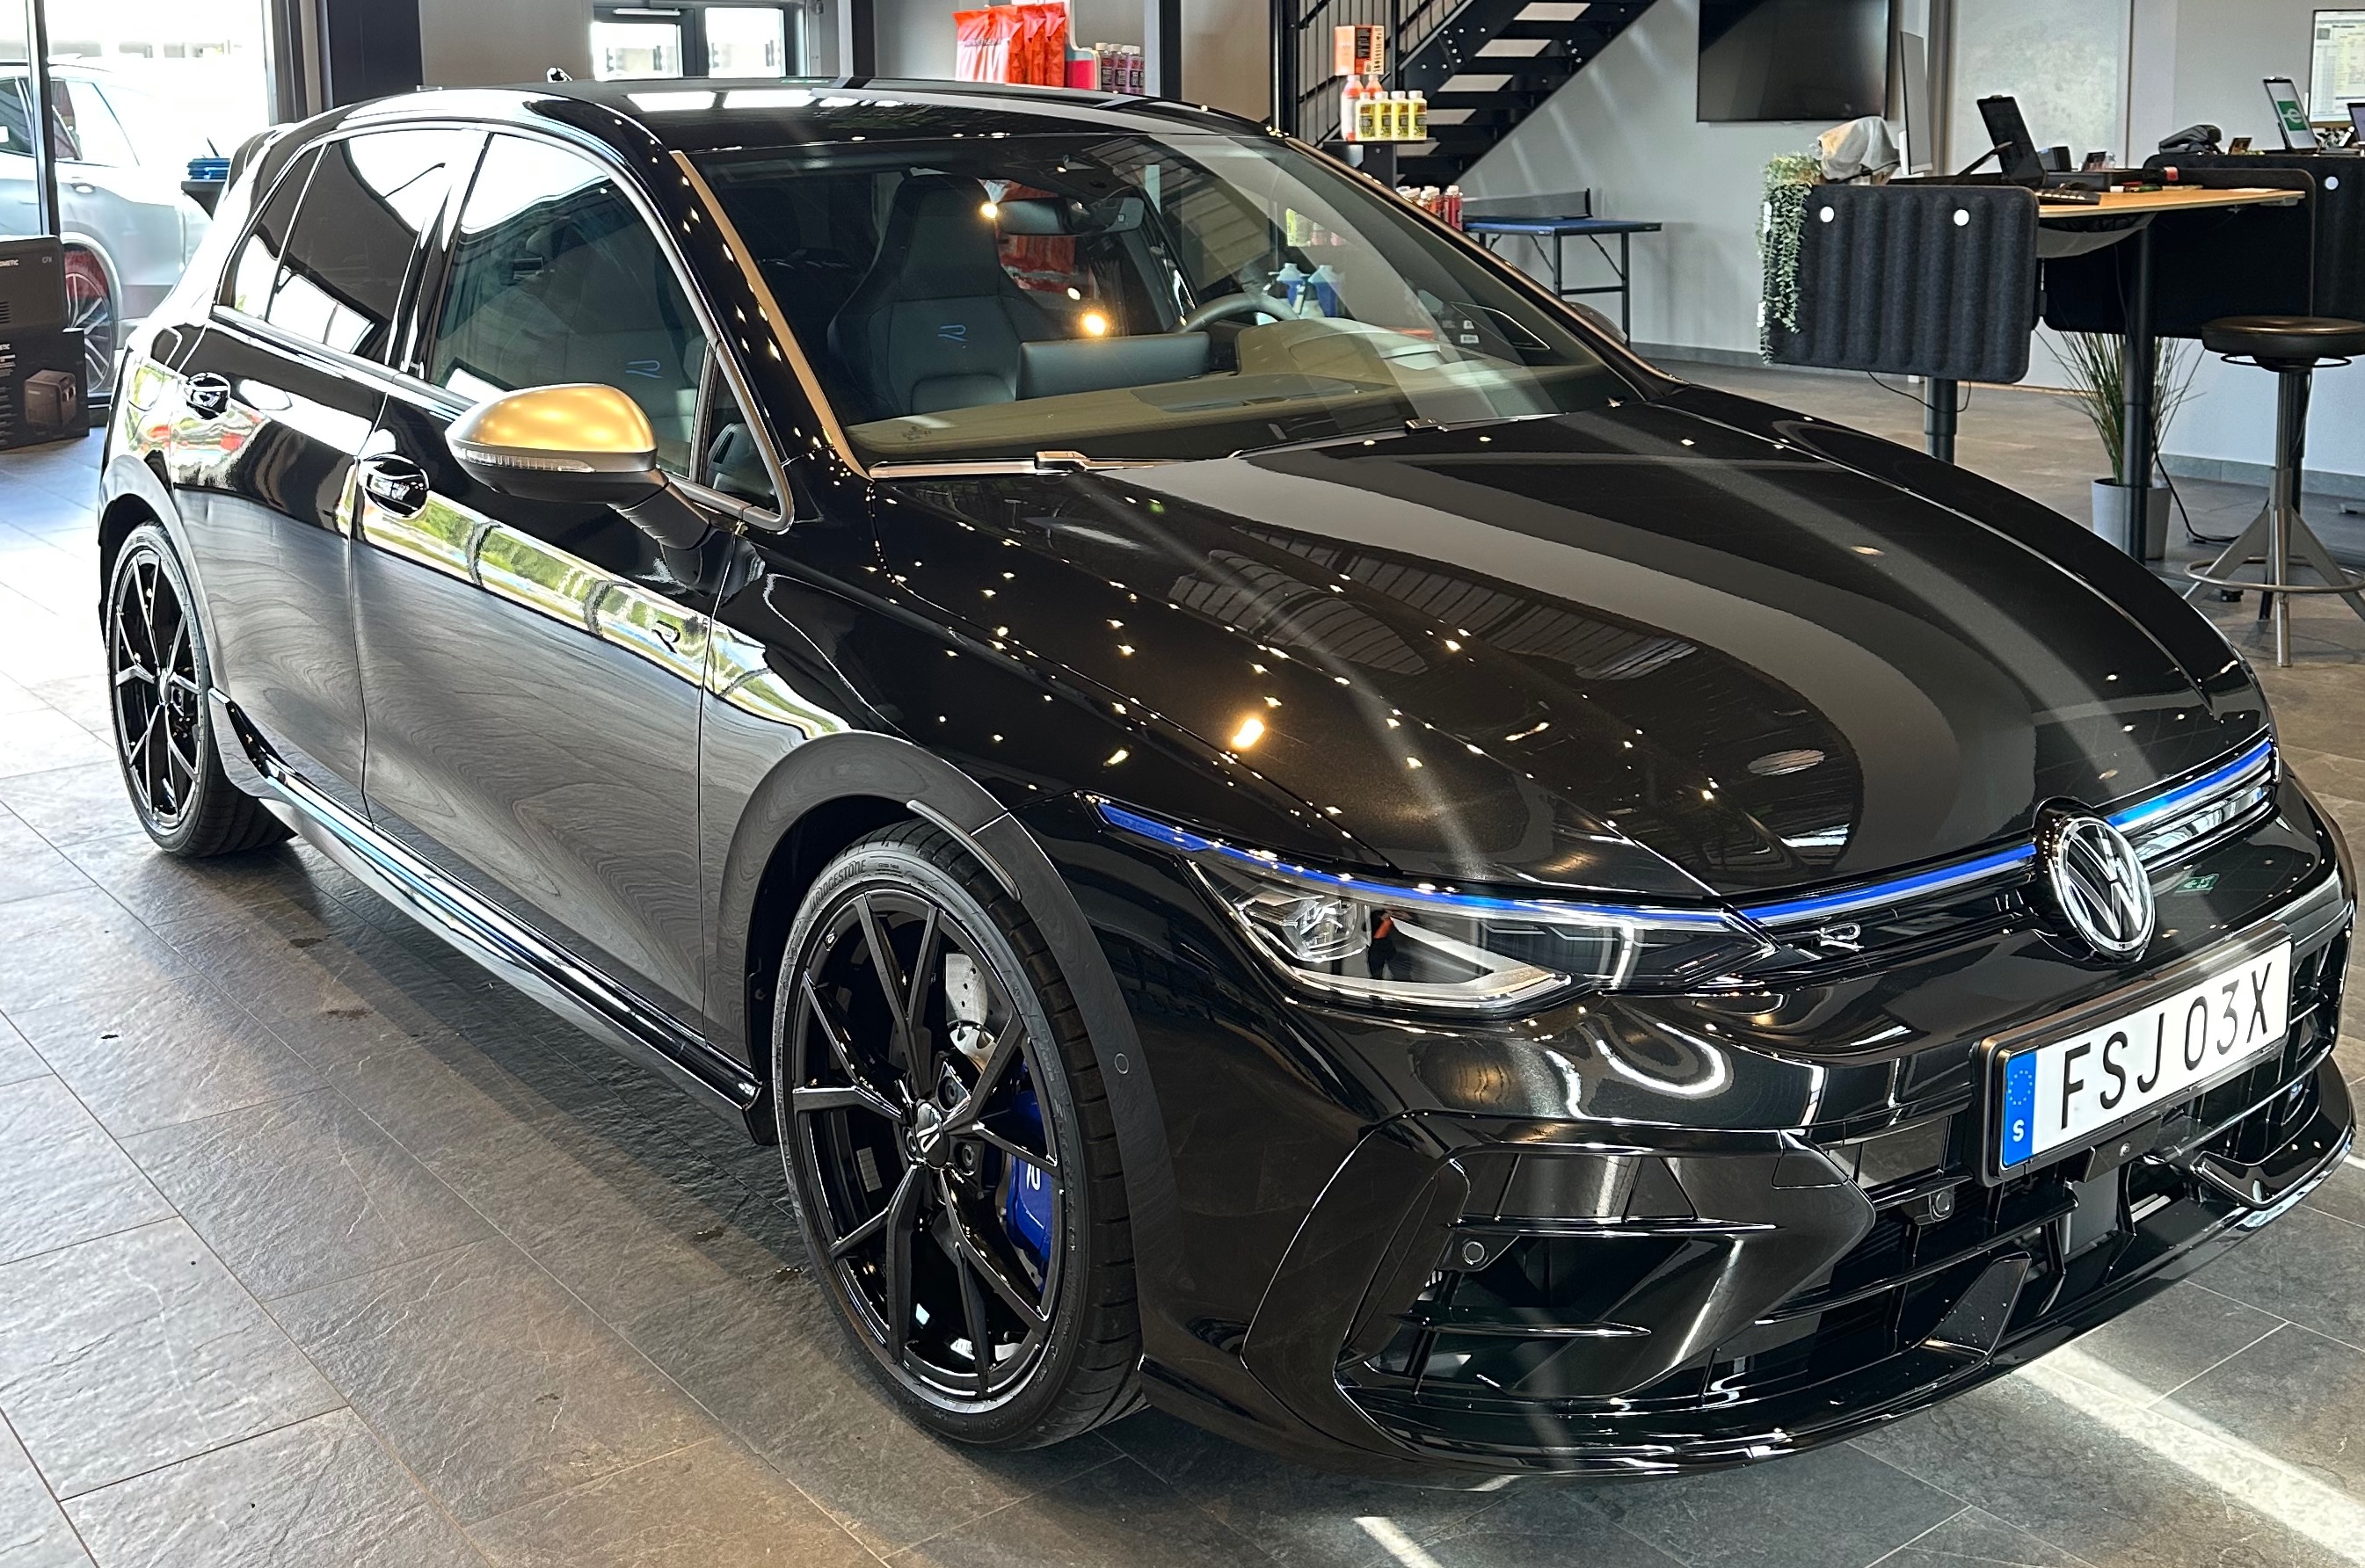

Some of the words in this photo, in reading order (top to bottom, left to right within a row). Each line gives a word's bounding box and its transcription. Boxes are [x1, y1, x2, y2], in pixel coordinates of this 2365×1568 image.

[809, 859, 867, 914] BRIDGESTONE
[2061, 1013, 2165, 1130] FSJ
[2184, 962, 2272, 1071] 03X
[2012, 1118, 2025, 1143] S
